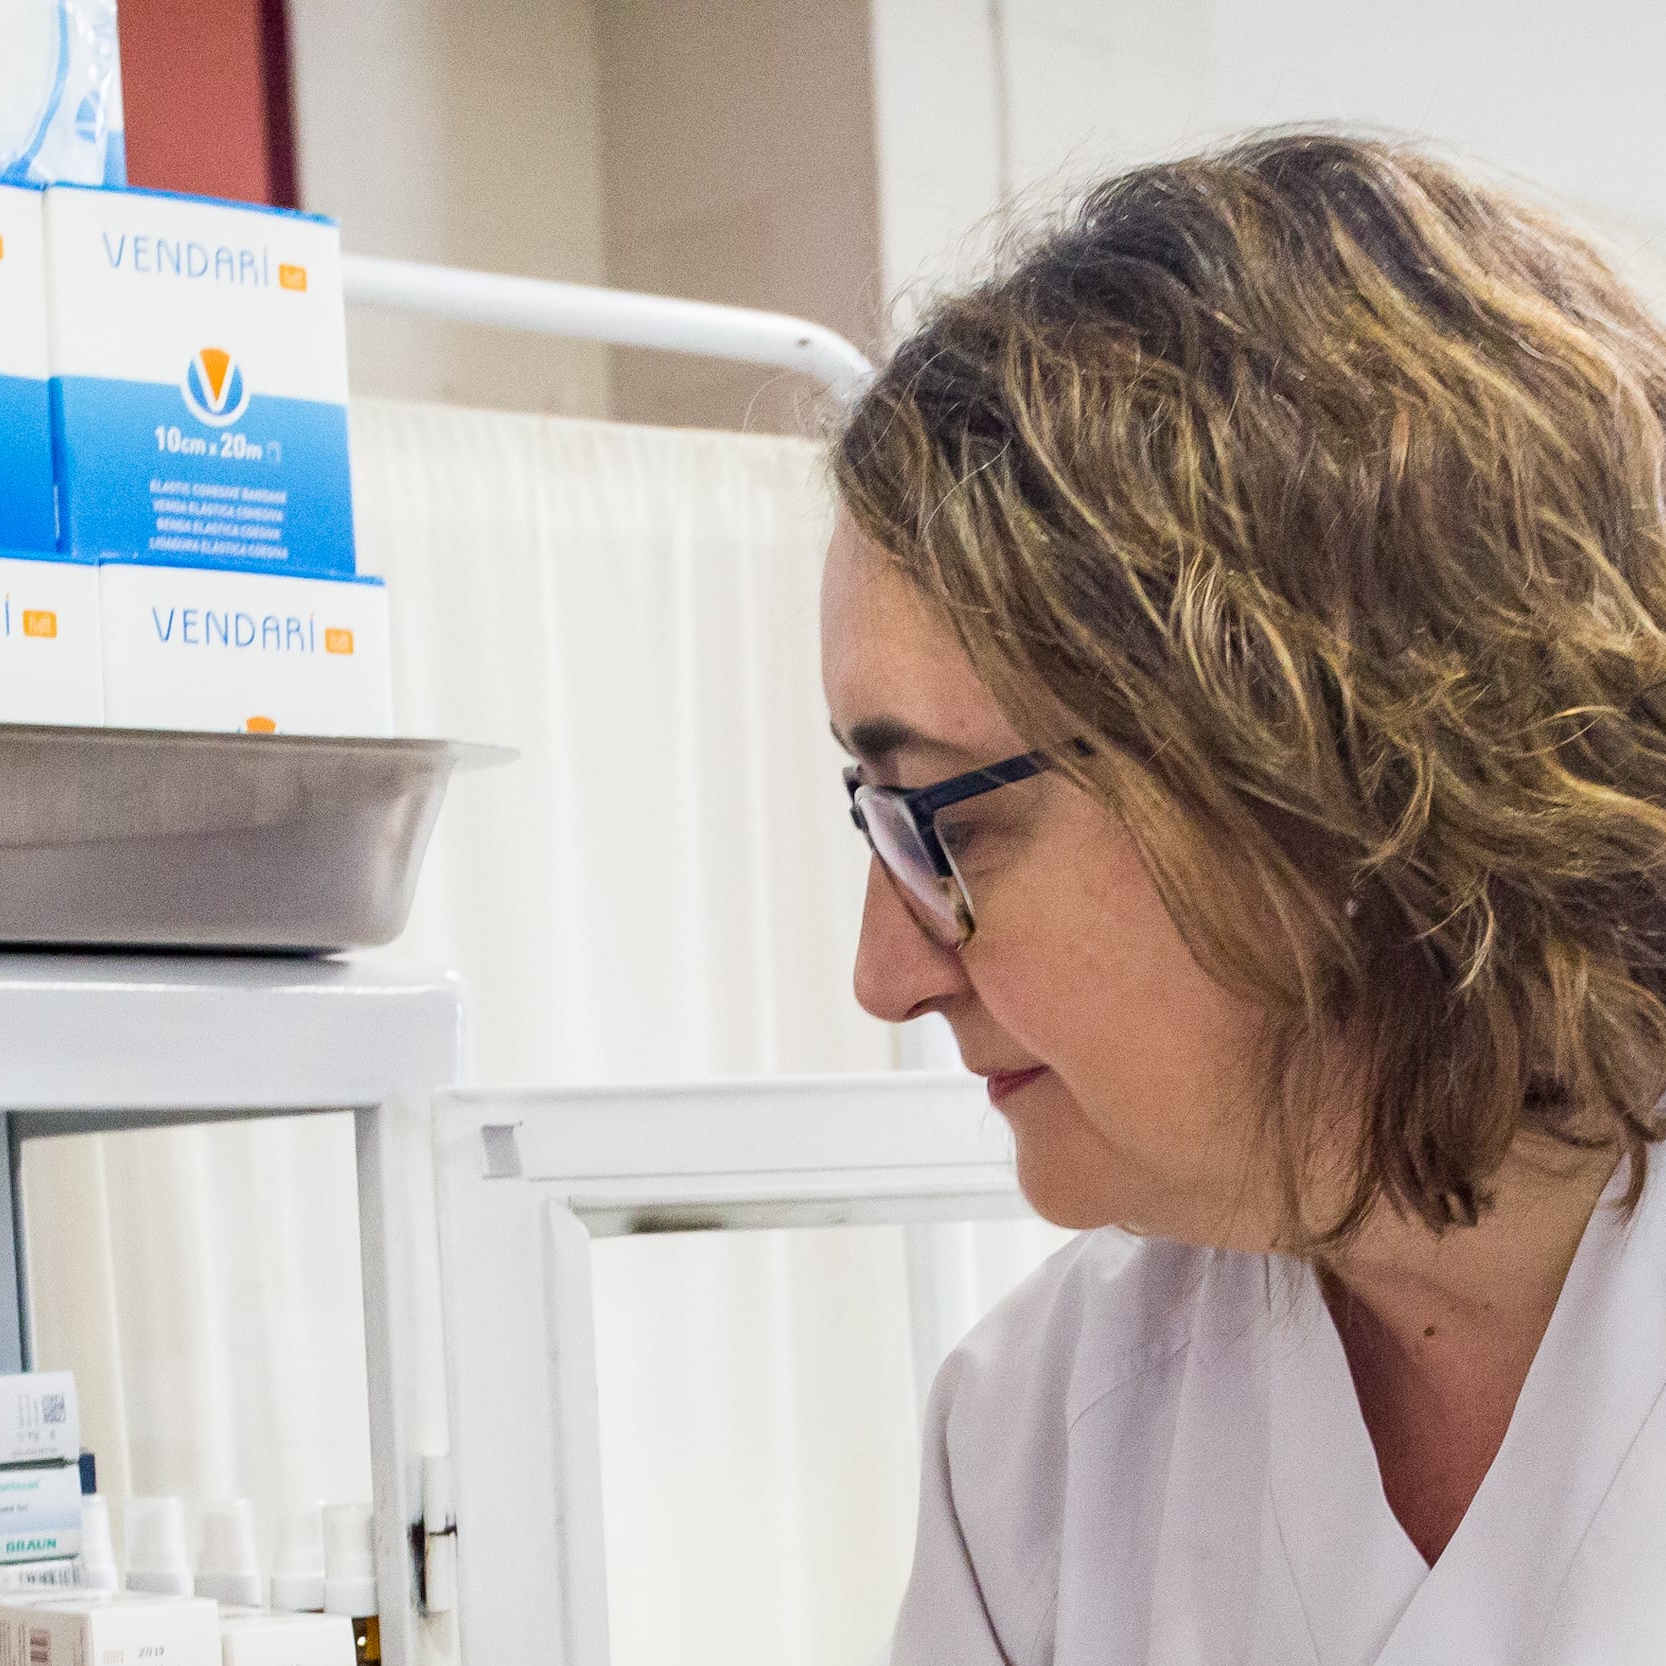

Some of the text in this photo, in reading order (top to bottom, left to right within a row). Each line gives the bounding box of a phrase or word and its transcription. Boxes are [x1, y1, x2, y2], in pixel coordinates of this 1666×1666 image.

[103, 231, 268, 288] VENDARÍ
[155, 426, 206, 456] 10cm
[219, 432, 262, 460] 20m
[151, 605, 314, 653] VENDARÍ
